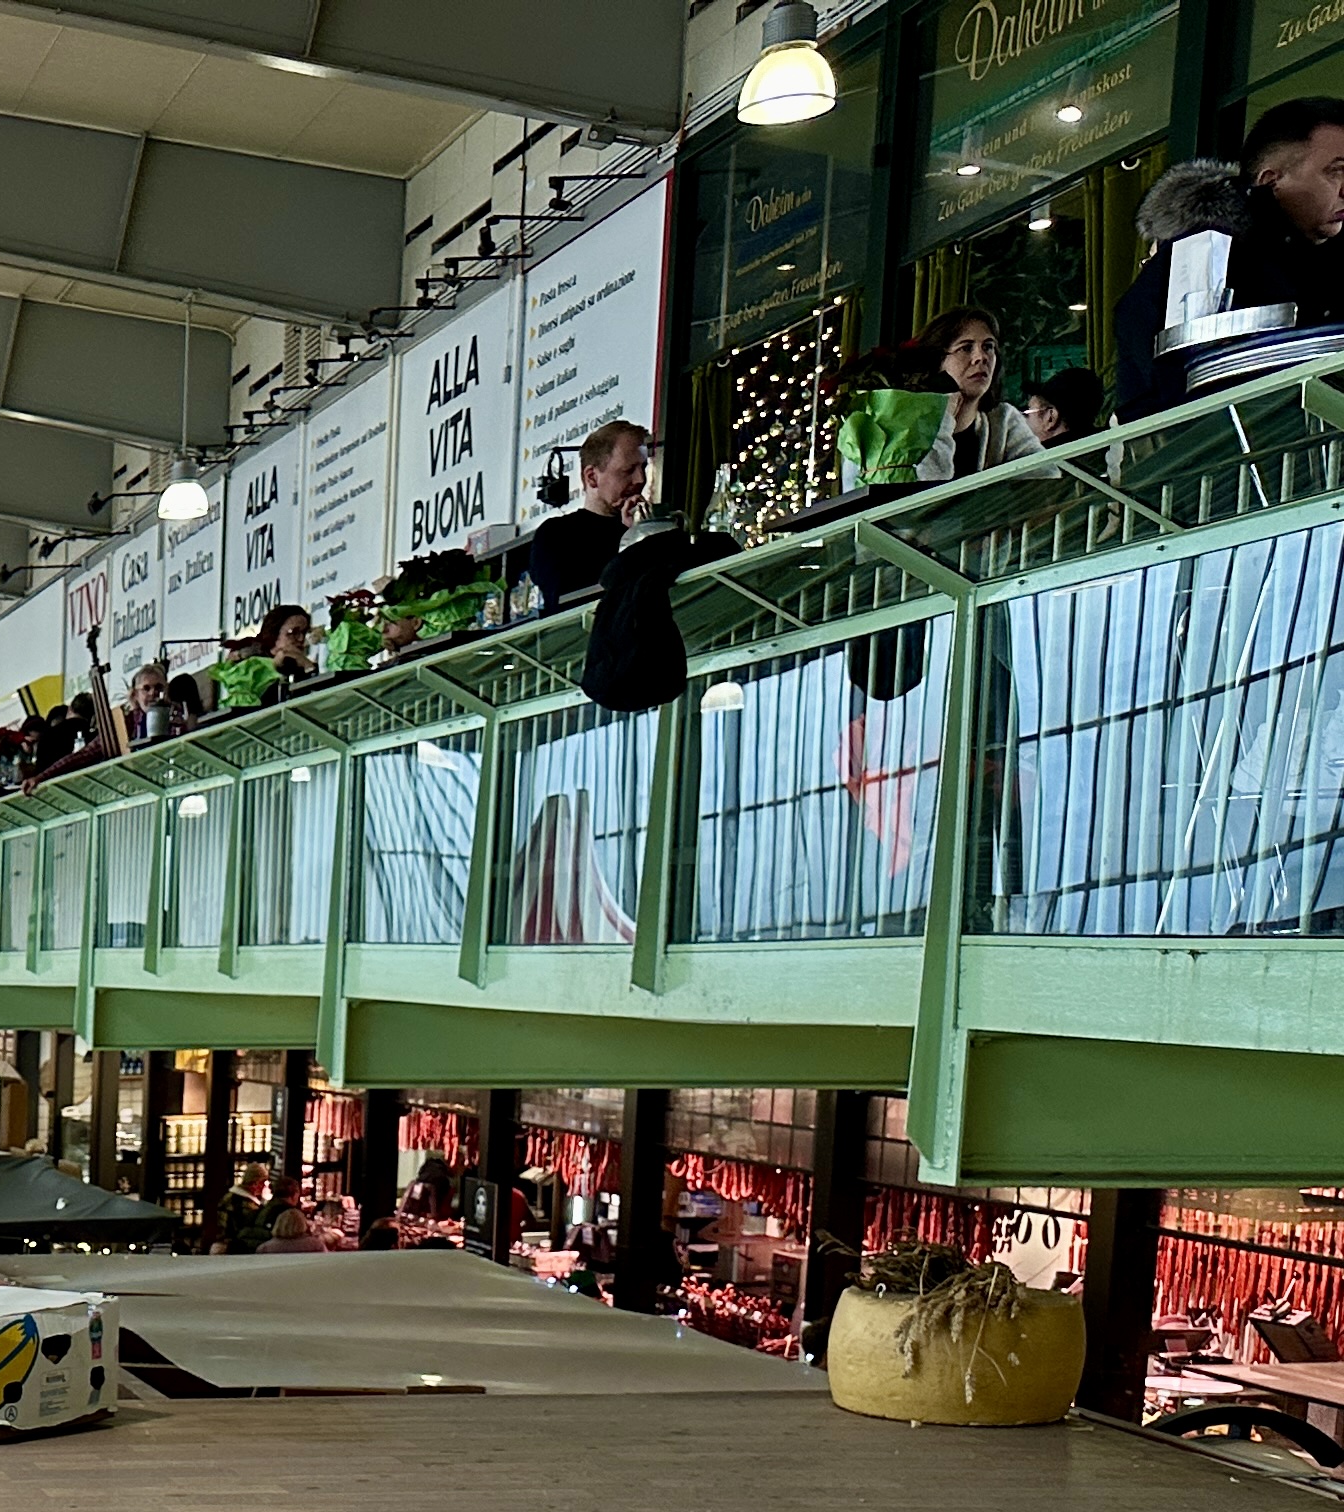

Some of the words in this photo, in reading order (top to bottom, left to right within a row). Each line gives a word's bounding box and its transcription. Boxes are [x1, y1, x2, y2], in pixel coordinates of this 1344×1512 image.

[425, 333, 480, 416] ALLA
[428, 408, 474, 478] VITA
[244, 463, 280, 523] ALLA
[411, 470, 486, 551] BUONA
[121, 551, 149, 593] Casa
[244, 520, 276, 574] VITA
[69, 571, 110, 640] VINO
[233, 578, 282, 634] BUONA
